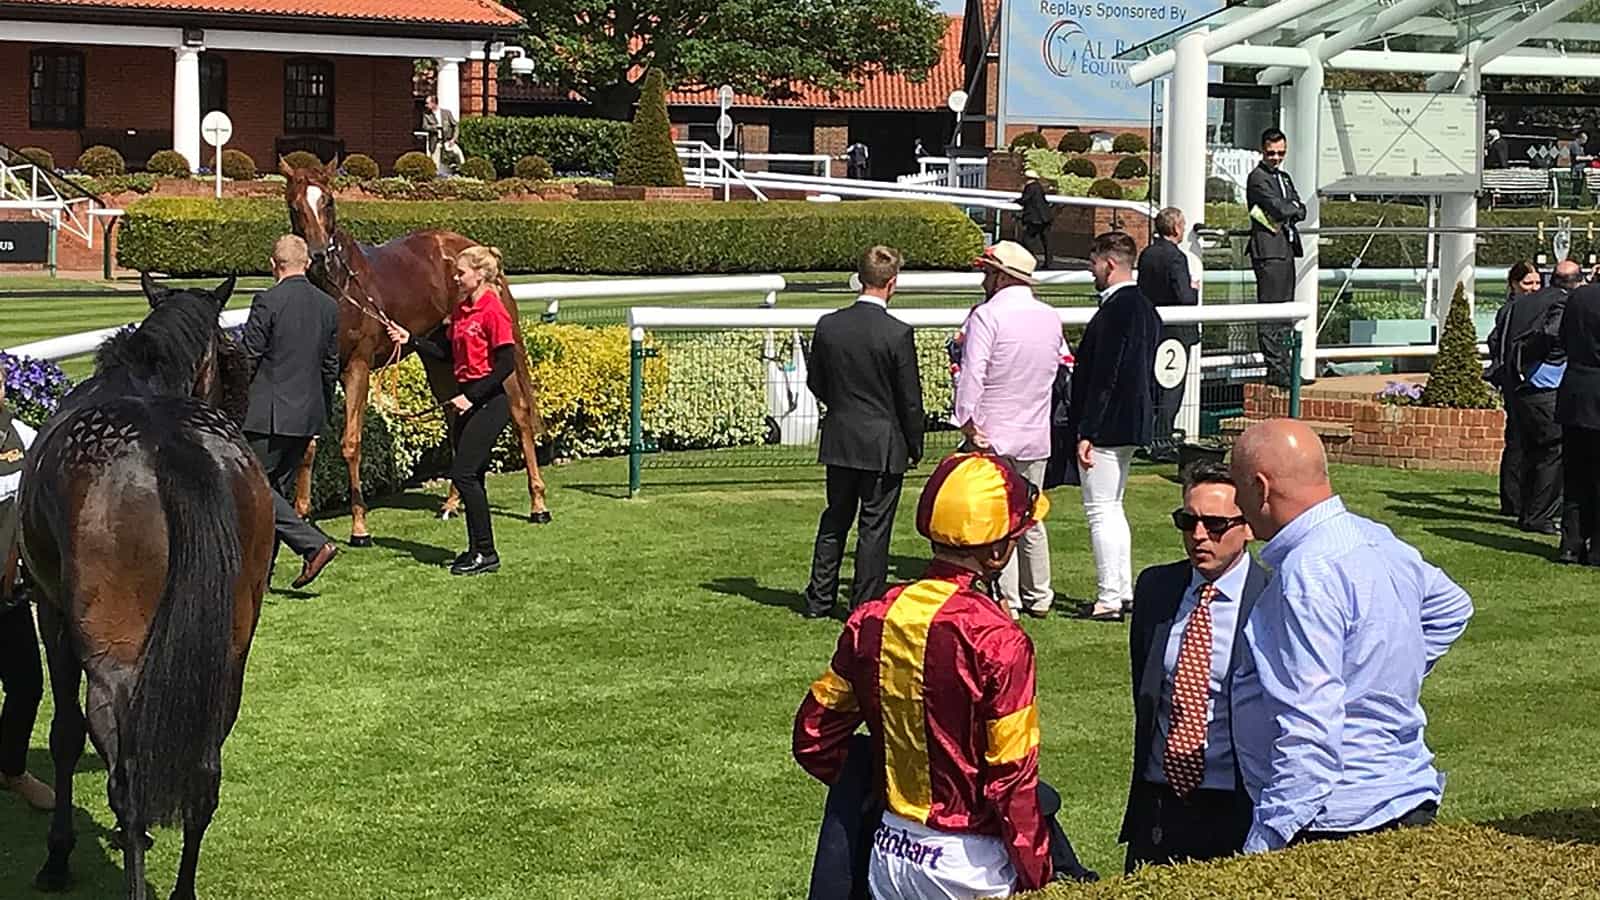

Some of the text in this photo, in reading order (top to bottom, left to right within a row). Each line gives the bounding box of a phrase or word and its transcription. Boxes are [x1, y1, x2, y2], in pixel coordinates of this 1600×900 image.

[1040, 1, 1187, 21] Replays Sponsored By
[1082, 39, 1106, 60] AL
[1165, 348, 1177, 370] 2
